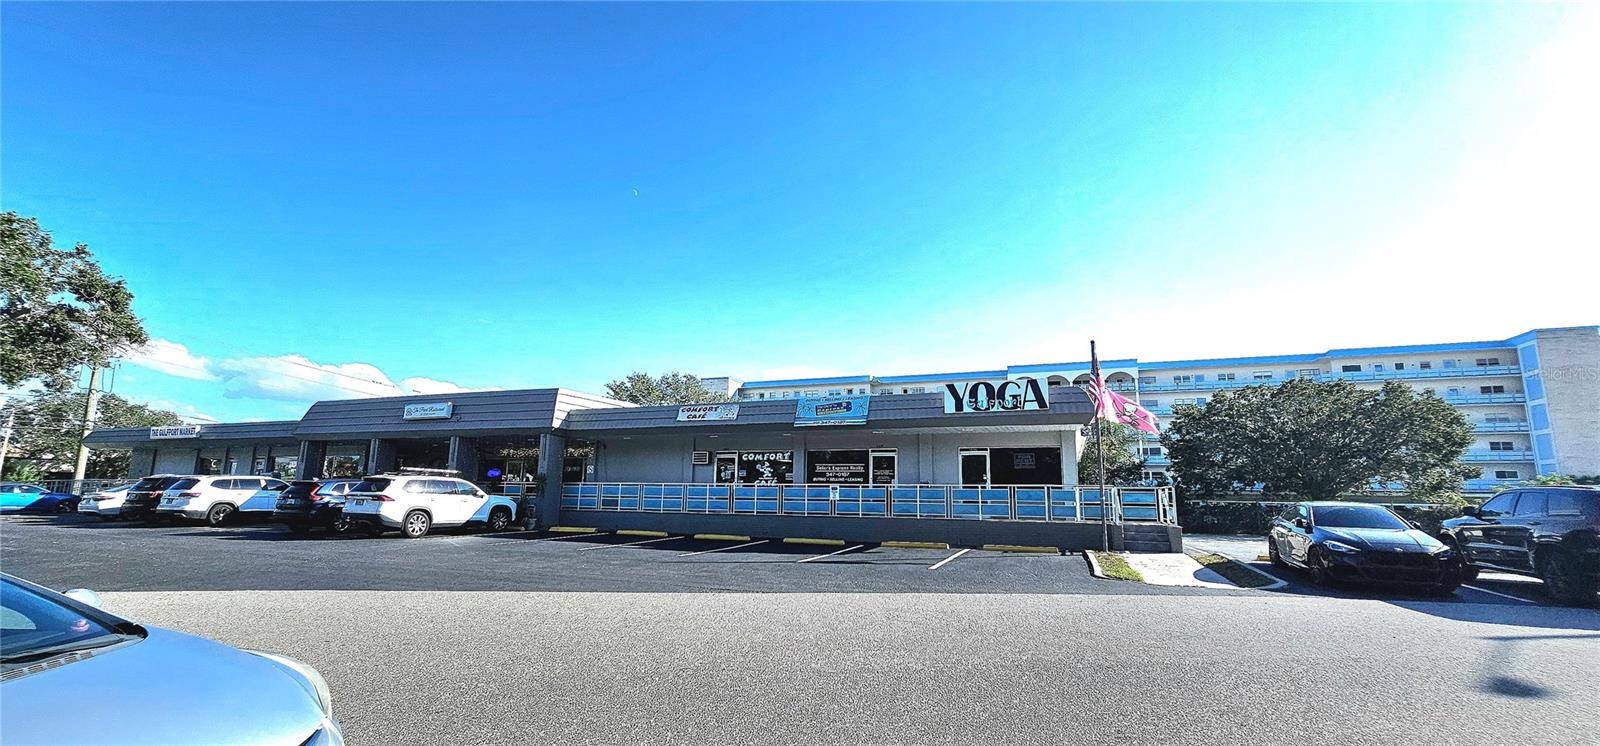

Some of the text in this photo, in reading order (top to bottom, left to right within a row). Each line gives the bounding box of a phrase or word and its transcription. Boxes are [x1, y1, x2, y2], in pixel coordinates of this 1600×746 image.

[945, 379, 1049, 413] YOGA
[179, 427, 196, 435] MARKET
[742, 452, 791, 461] COMFORT
